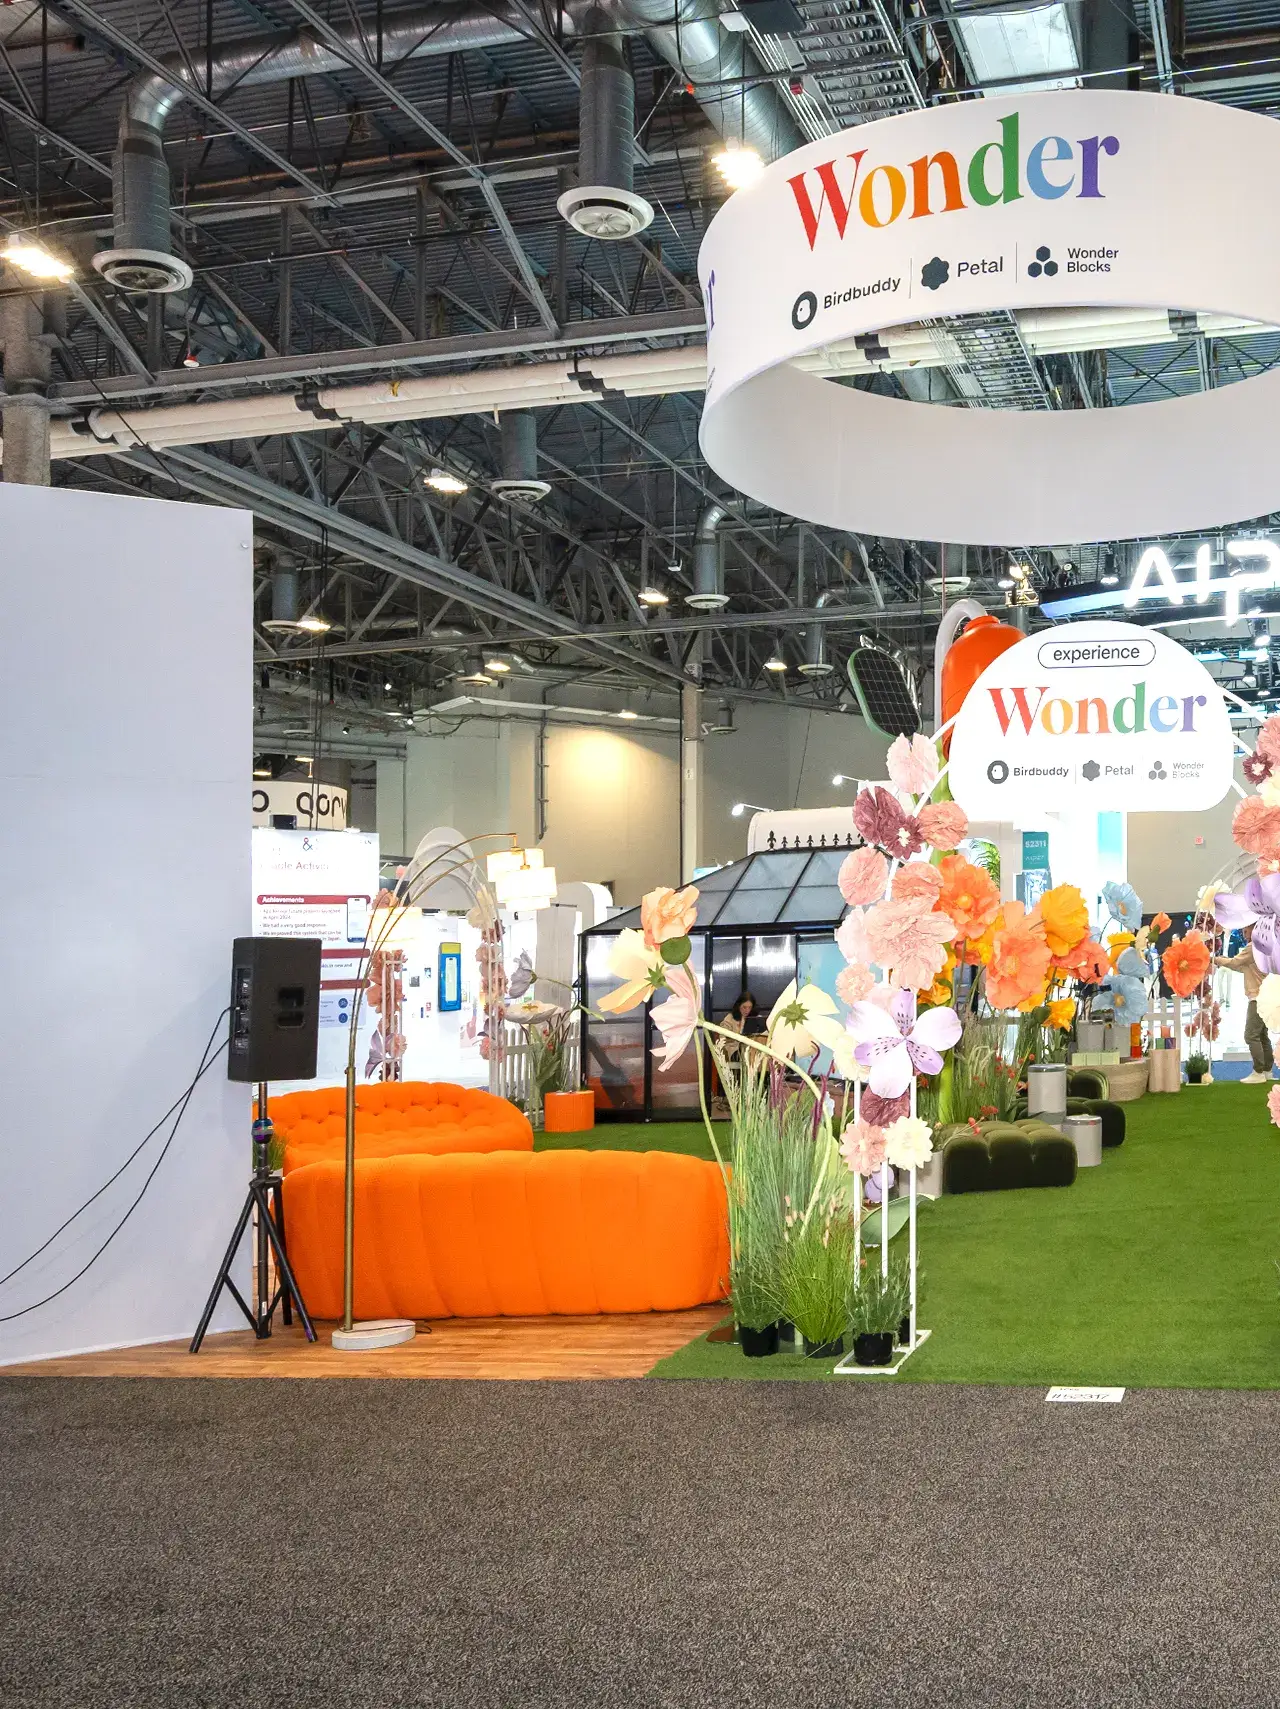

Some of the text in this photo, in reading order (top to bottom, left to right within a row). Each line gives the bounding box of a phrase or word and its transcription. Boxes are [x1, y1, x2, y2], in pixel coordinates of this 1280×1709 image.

[786, 111, 1120, 251] Wonder
[1067, 246, 1119, 259] Wonder
[957, 256, 1004, 277] Petal
[1067, 260, 1111, 273] Blocks
[823, 277, 901, 309] Birdbuddy
[1053, 645, 1140, 663] experience
[986, 681, 1207, 737] Wonder
[1013, 767, 1069, 777] Birdbuddy
[1105, 765, 1134, 776] Petal
[1173, 762, 1204, 770] Wonder
[1172, 770, 1199, 778] Blocks
